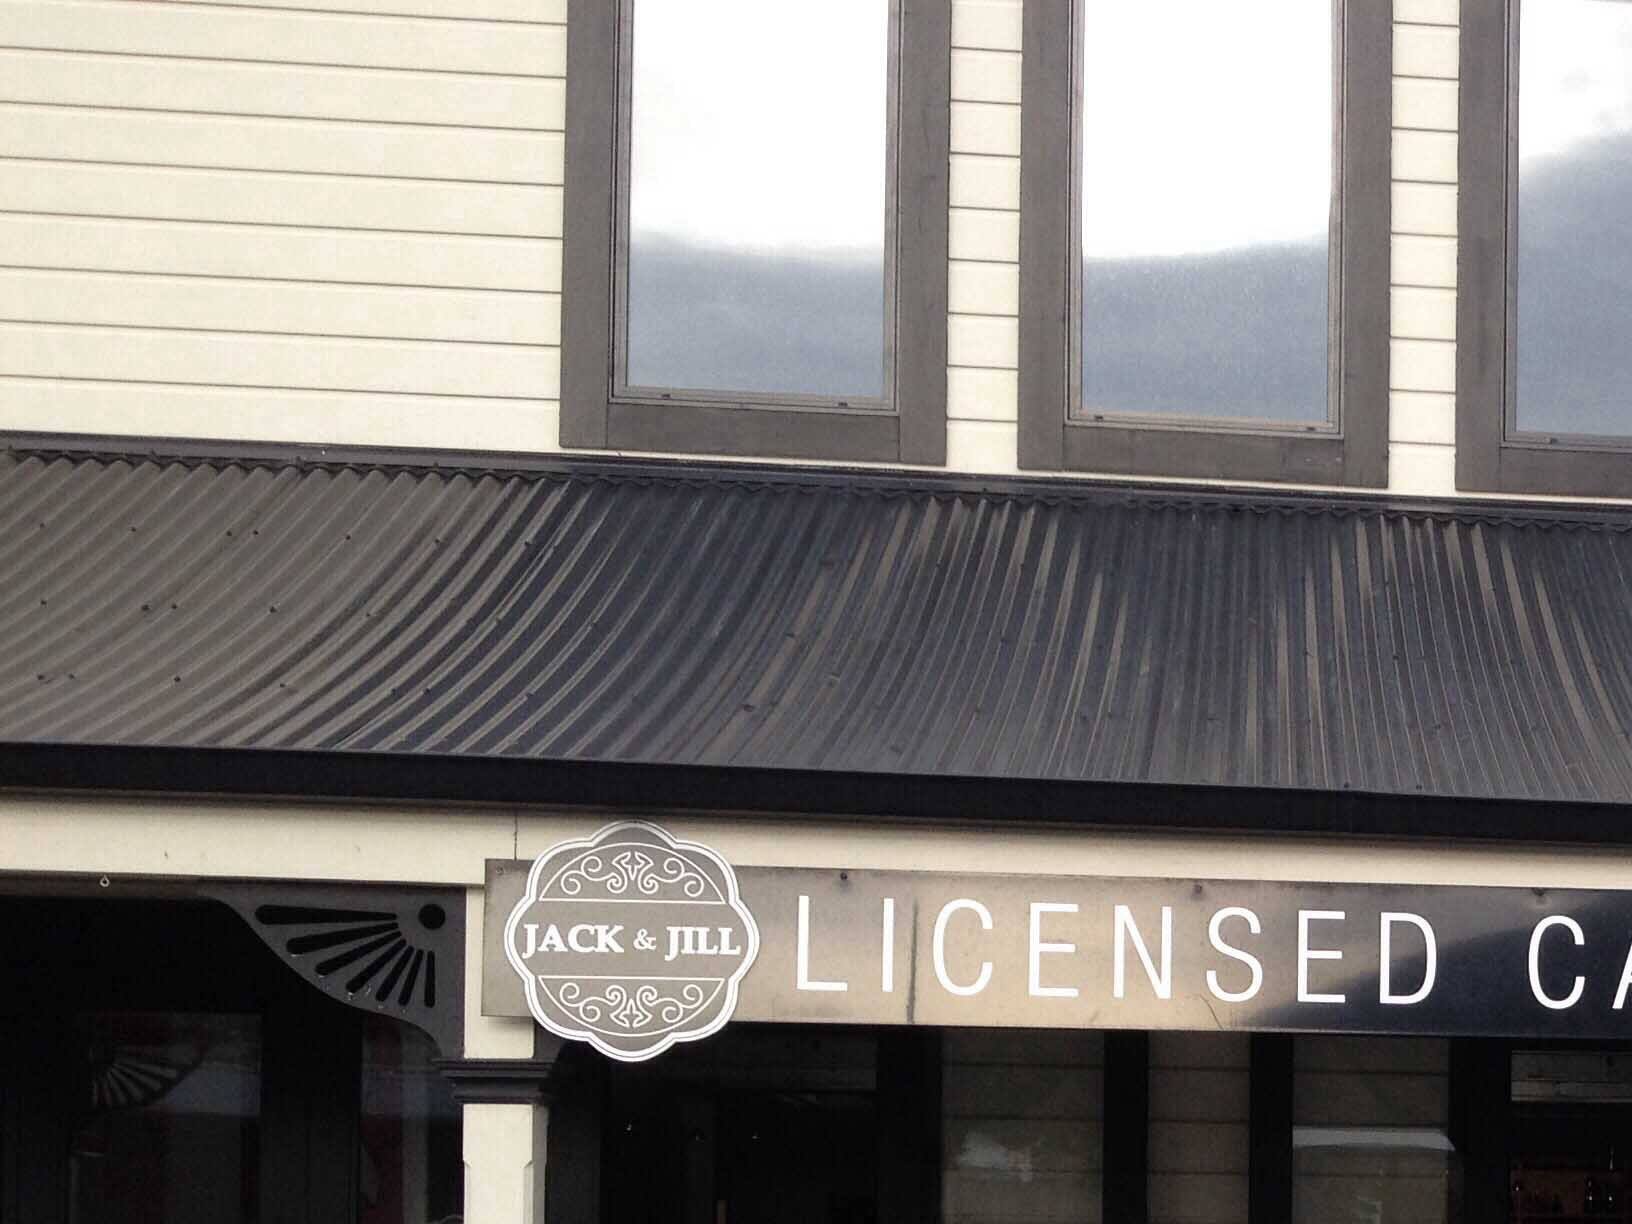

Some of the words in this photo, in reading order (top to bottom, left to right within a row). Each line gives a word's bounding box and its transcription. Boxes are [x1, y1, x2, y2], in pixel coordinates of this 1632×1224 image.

[521, 923, 625, 960] JACK
[632, 928, 657, 951] &
[663, 925, 742, 962] JILL
[796, 894, 1439, 1006] LICENSED
